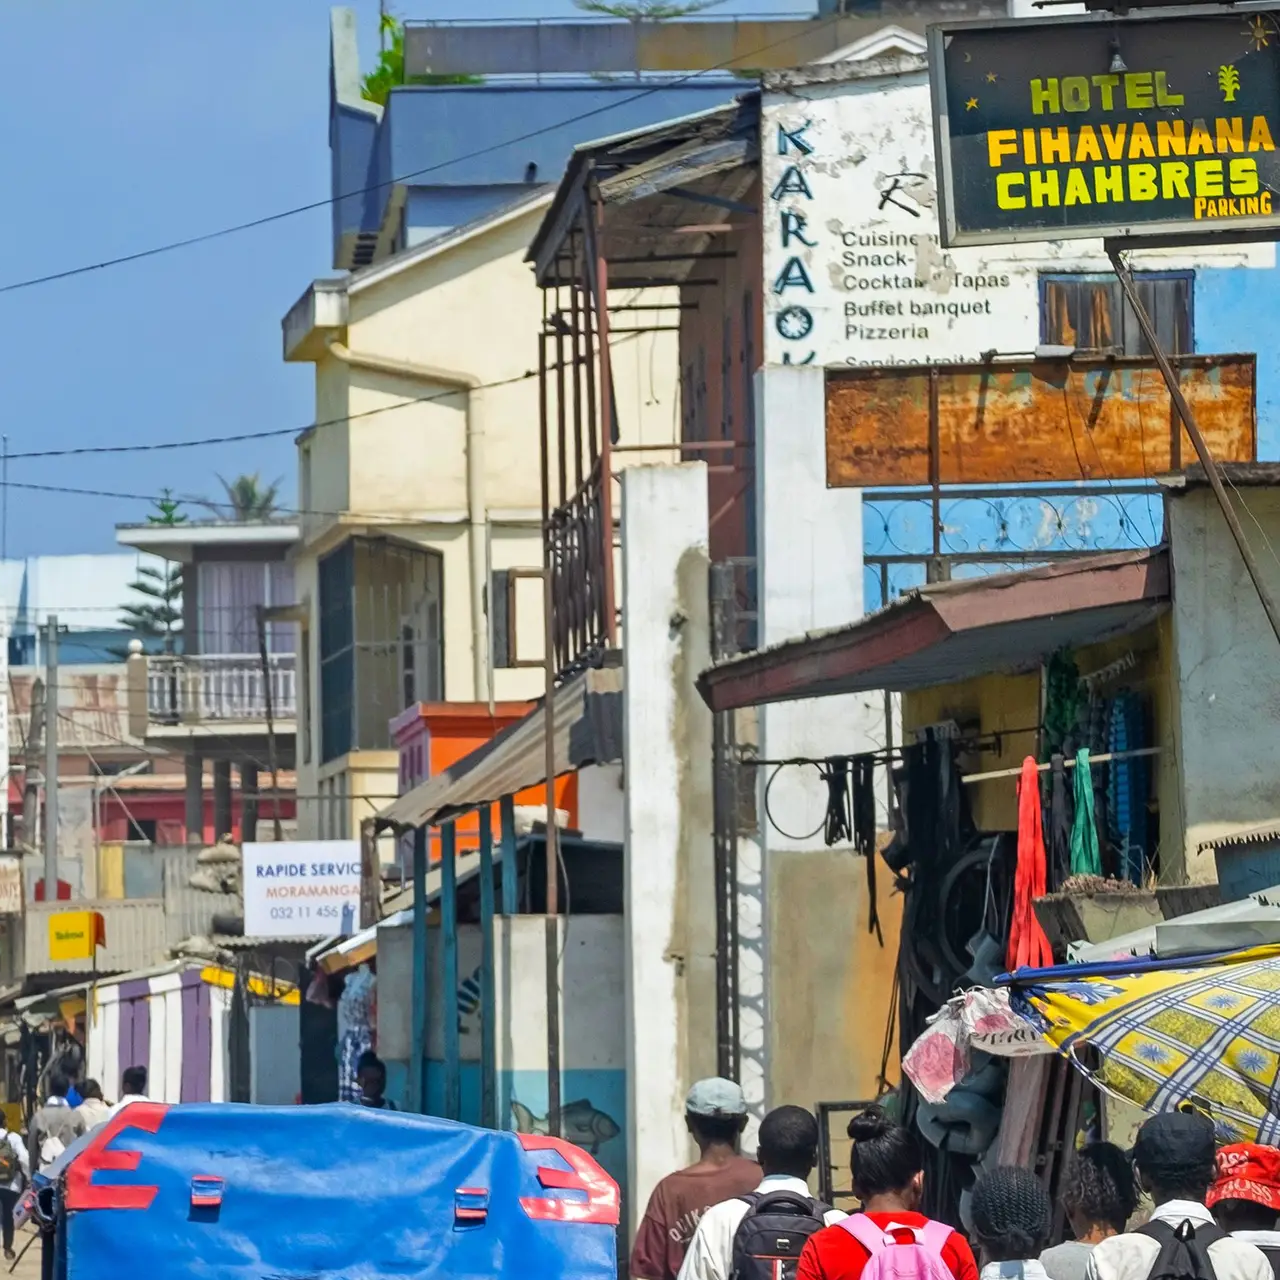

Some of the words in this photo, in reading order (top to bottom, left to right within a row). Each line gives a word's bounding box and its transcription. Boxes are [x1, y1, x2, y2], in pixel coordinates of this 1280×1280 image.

[1030, 71, 1184, 115] HOTEL
[987, 115, 1276, 168] FIHAVANANA
[996, 158, 1260, 210] CHAMBRES
[1194, 192, 1272, 220] PARKING
[844, 301, 904, 317] Buffet
[910, 299, 992, 319] banquet
[845, 323, 930, 341] Pizzeria
[255, 863, 307, 878] RAPIDE
[265, 884, 360, 899] MORAMANGA
[270, 906, 293, 919] 032
[298, 906, 311, 919] 11
